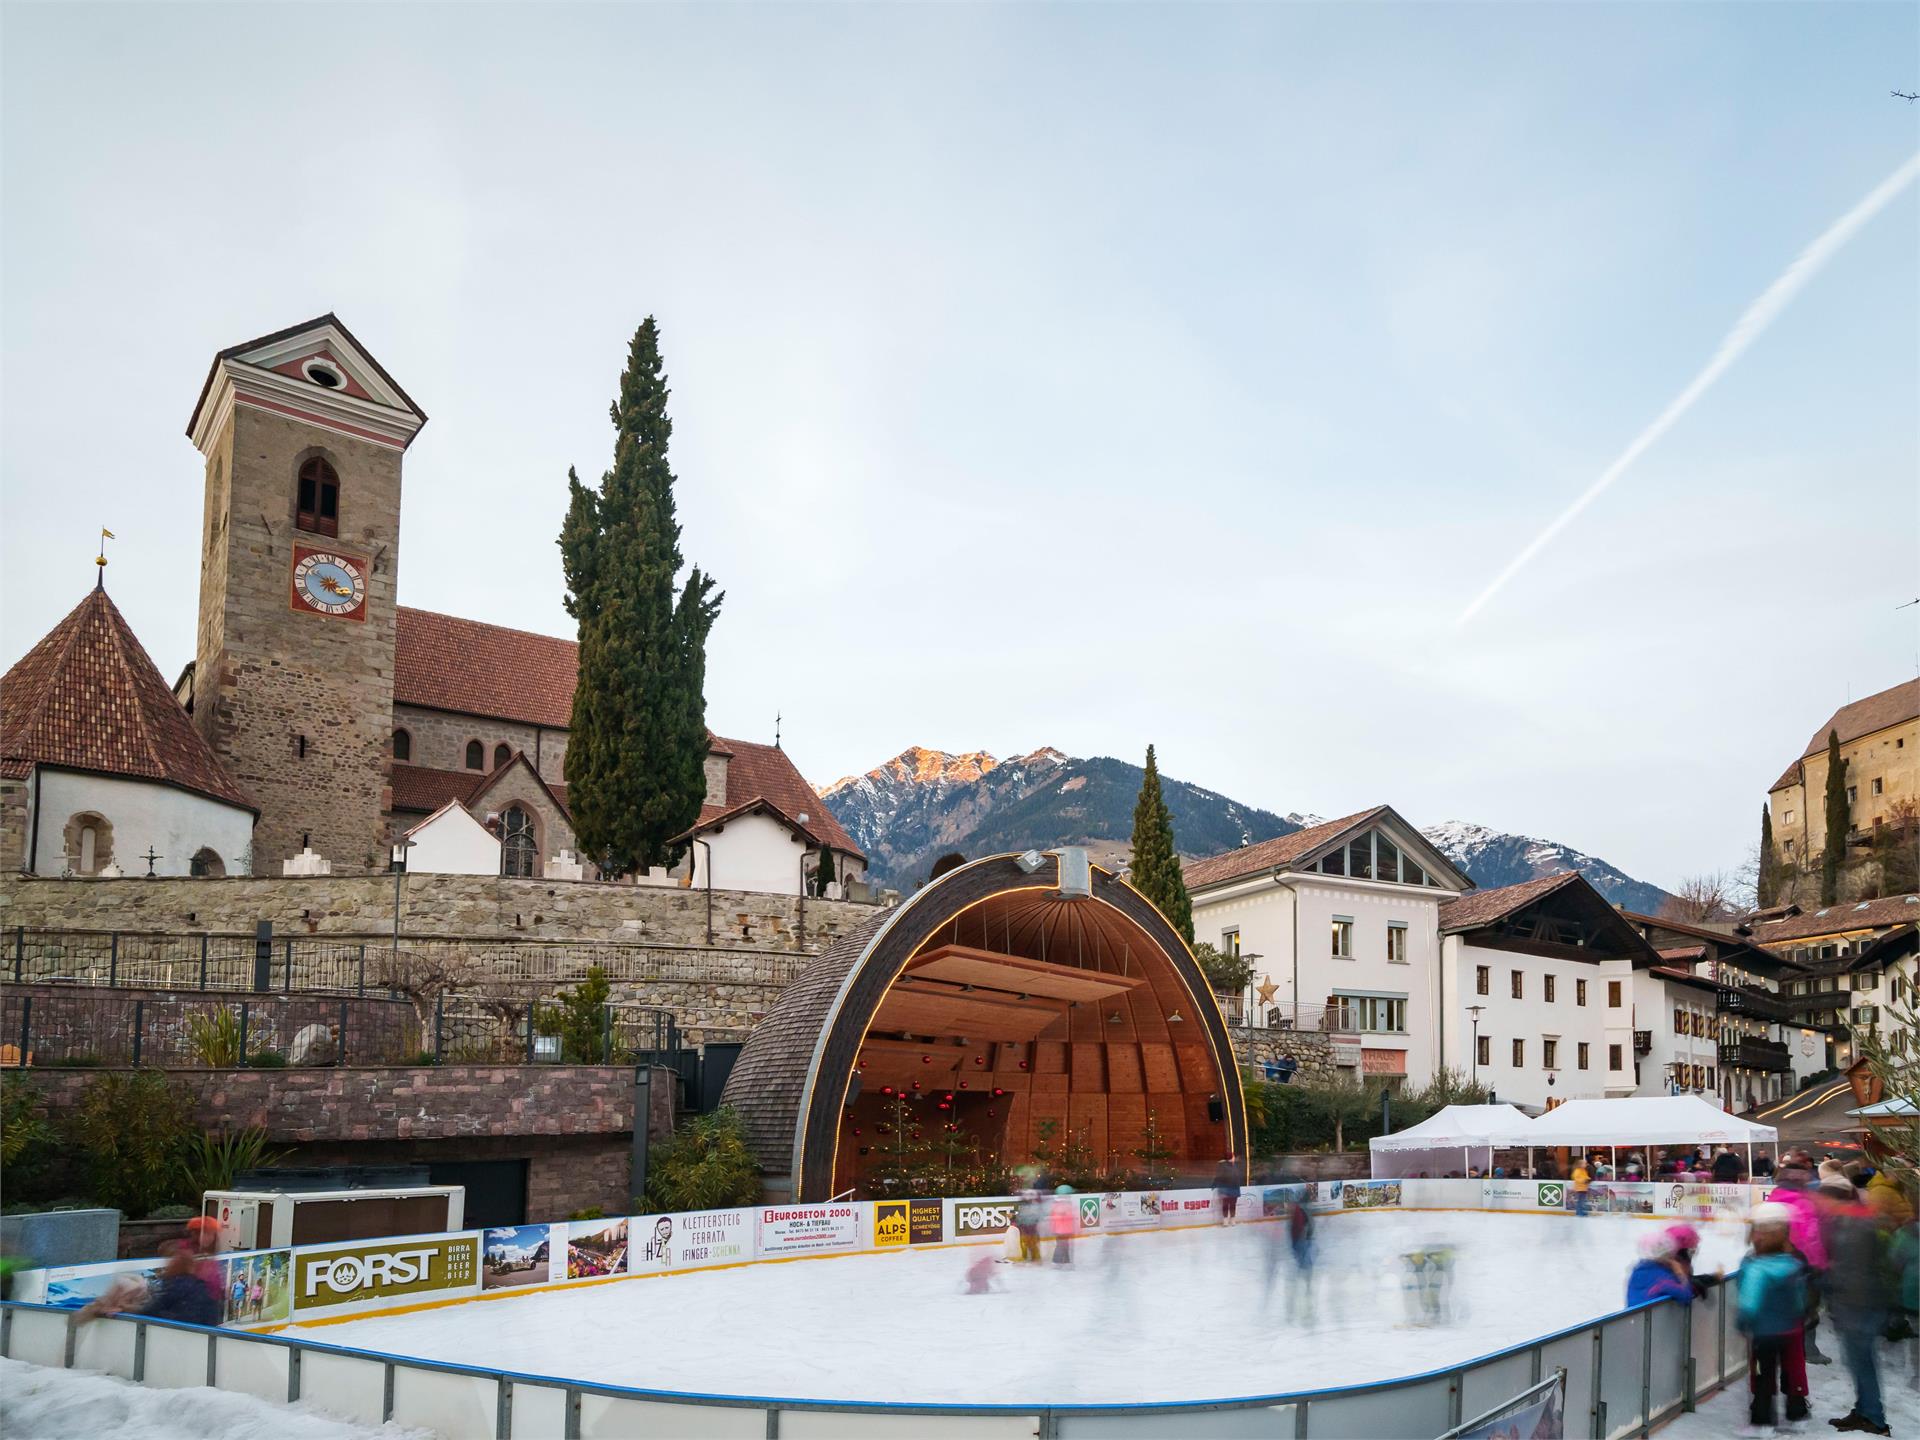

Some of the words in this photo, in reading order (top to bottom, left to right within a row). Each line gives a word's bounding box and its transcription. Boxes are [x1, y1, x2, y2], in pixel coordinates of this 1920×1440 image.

[774, 1209, 826, 1221] EUROBETON
[829, 1208, 851, 1218] 2000
[912, 1207, 940, 1215] HIGHEST
[682, 1213, 741, 1230] KLETTERSTEIG
[959, 1206, 1015, 1230] FORST
[878, 1224, 906, 1235] ALPS
[692, 1231, 726, 1244] FERRATA
[448, 1244, 471, 1253] BIRRA
[448, 1253, 470, 1262] BIERE
[447, 1262, 470, 1270] BEER
[306, 1248, 439, 1296] FORST
[447, 1270, 470, 1279] BIER
